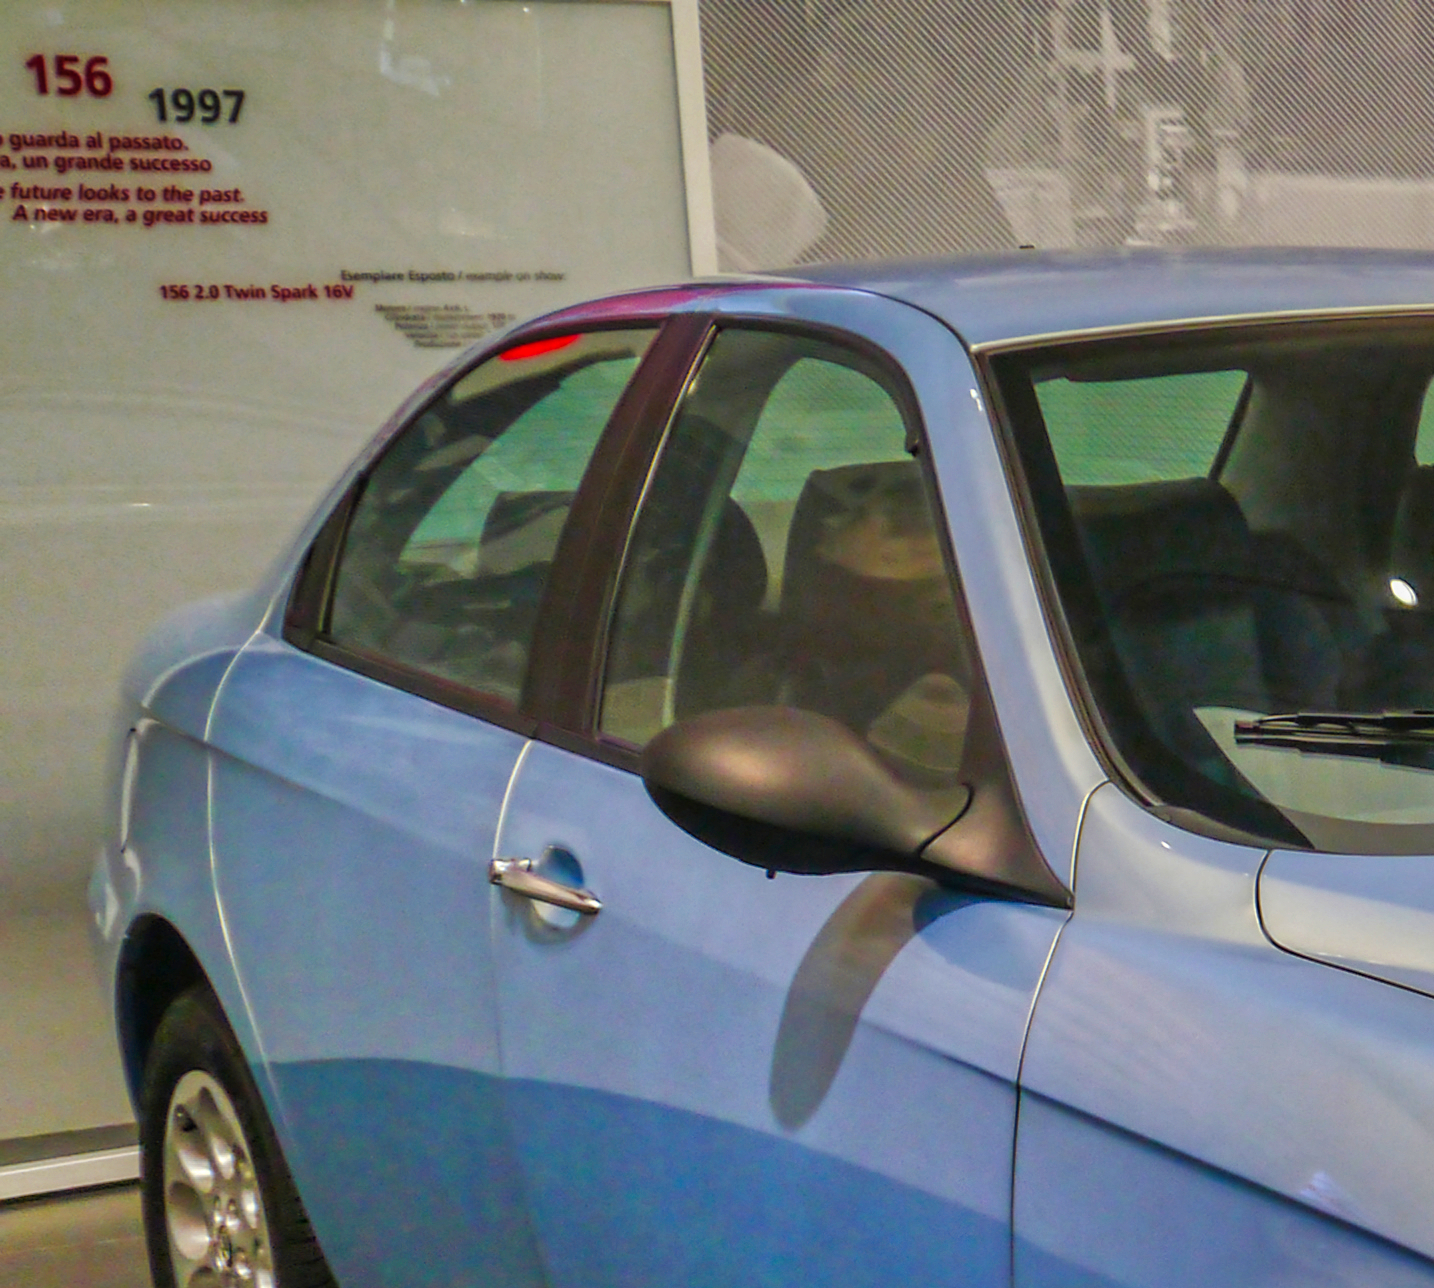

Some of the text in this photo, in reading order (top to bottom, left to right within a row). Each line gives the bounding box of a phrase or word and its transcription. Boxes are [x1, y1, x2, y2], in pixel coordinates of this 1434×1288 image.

[25, 54, 113, 97] 156
[149, 88, 245, 124] 1997
[9, 131, 79, 151] guarda
[86, 131, 102, 149] al
[109, 134, 189, 153] passato.
[23, 155, 48, 169] un
[54, 153, 124, 173] grande
[130, 157, 212, 173] successo
[11, 181, 72, 200] future
[79, 183, 130, 201] looks
[137, 185, 156, 201] to
[163, 185, 194, 202] the
[199, 188, 244, 206] past.
[12, 204, 268, 227] A new era, a great success
[160, 283, 355, 302] 156 2.0 Twin Spark 16V
